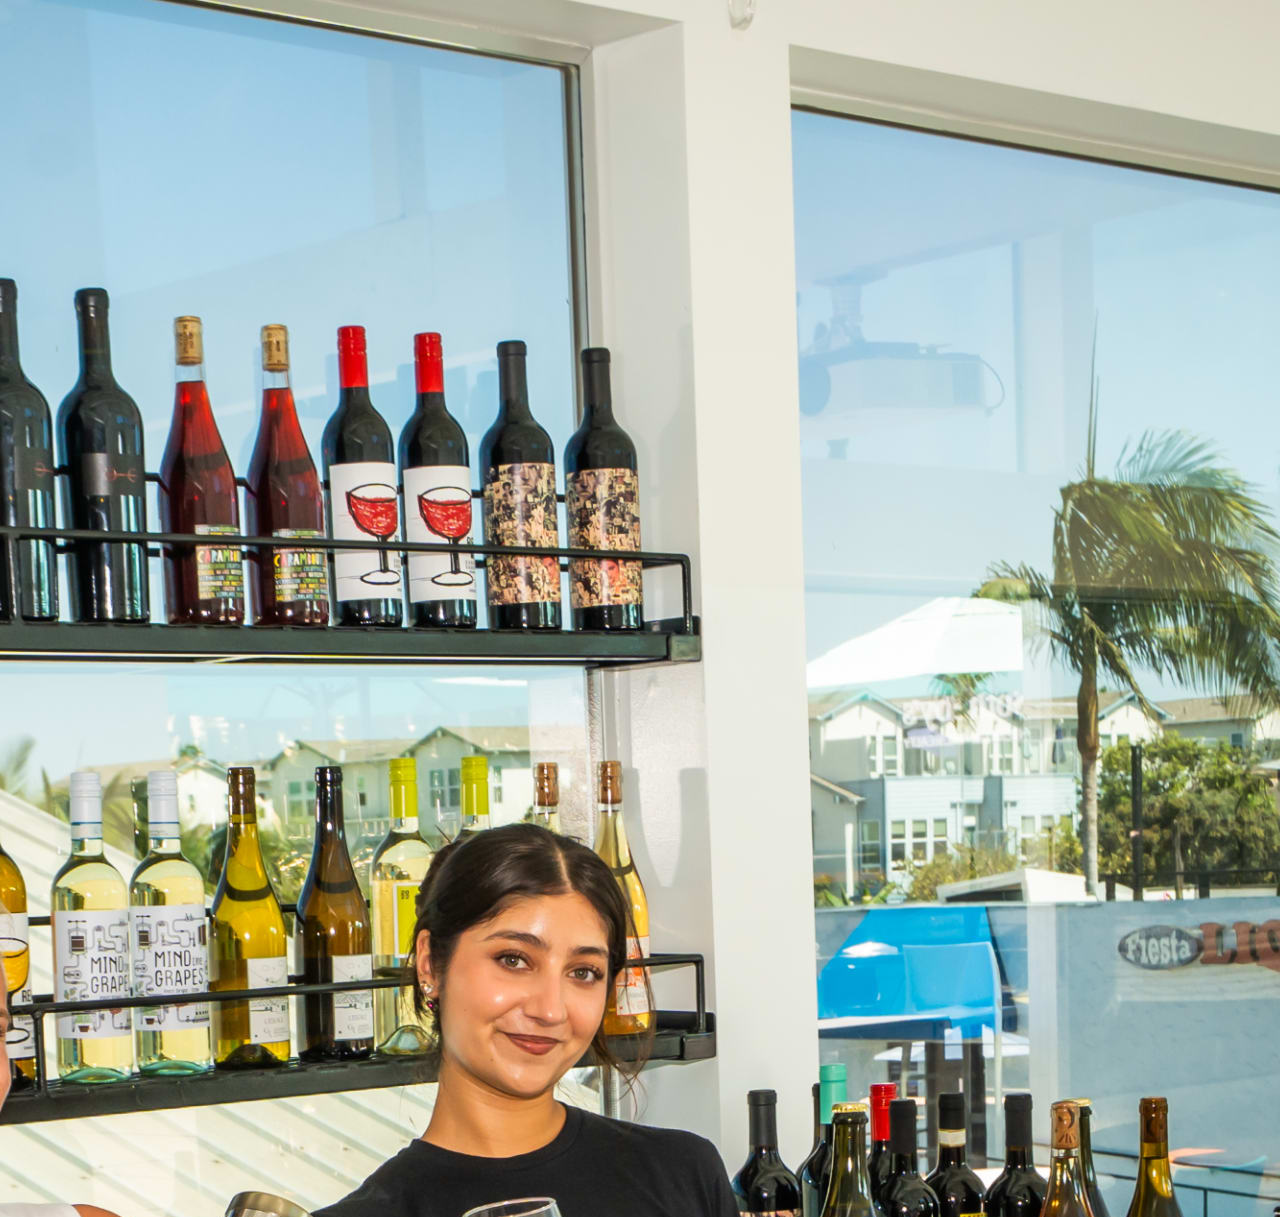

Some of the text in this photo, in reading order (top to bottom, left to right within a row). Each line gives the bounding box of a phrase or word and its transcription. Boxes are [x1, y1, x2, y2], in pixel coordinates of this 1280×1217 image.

[1124, 930, 1193, 965] Fiesta
[90, 956, 124, 974] MIND
[154, 949, 191, 967] MIND
[154, 967, 204, 987] GRAPES
